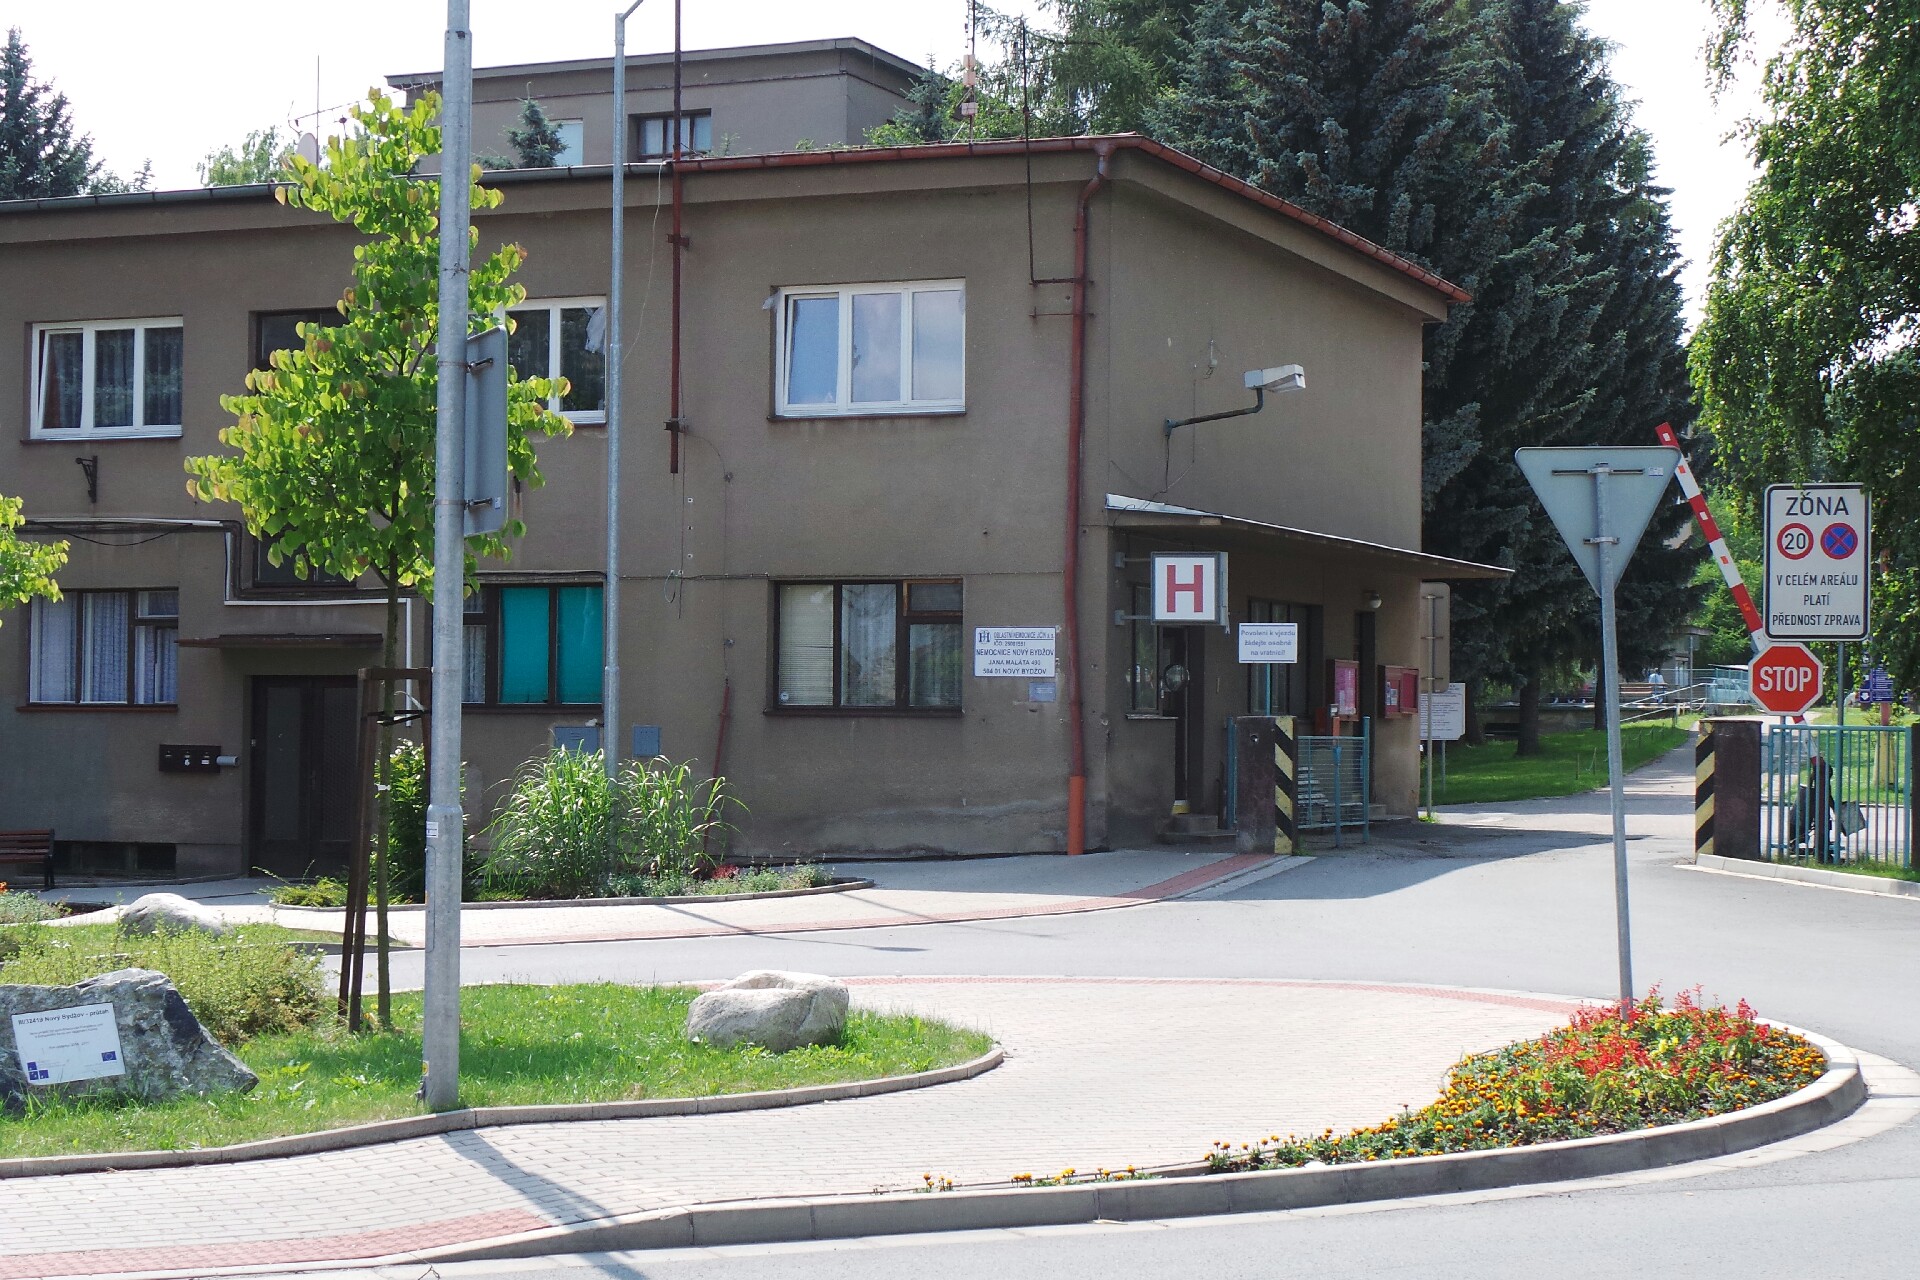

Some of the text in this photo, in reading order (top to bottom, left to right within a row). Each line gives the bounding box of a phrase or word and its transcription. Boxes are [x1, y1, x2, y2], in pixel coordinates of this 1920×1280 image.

[1786, 491, 1849, 516] ZÓNA
[1784, 533, 1806, 550] 20
[1777, 572, 1858, 586] V CELÉM AREÁLU
[1166, 564, 1204, 613] H
[1803, 592, 1830, 606] PLATÍ
[1773, 612, 1860, 626] PŘEDNOST ZPRAVA
[1275, 630, 1296, 638] vjezdu
[1244, 639, 1267, 647] žádejte
[976, 647, 1054, 656] NEMOCNICE NOVÝ BYDŽOV
[1002, 667, 1020, 675] NOVÝ
[1021, 667, 1047, 675] BYDŽOV
[1759, 666, 1812, 692] STOP
[61, 1011, 85, 1021] Bydžov
